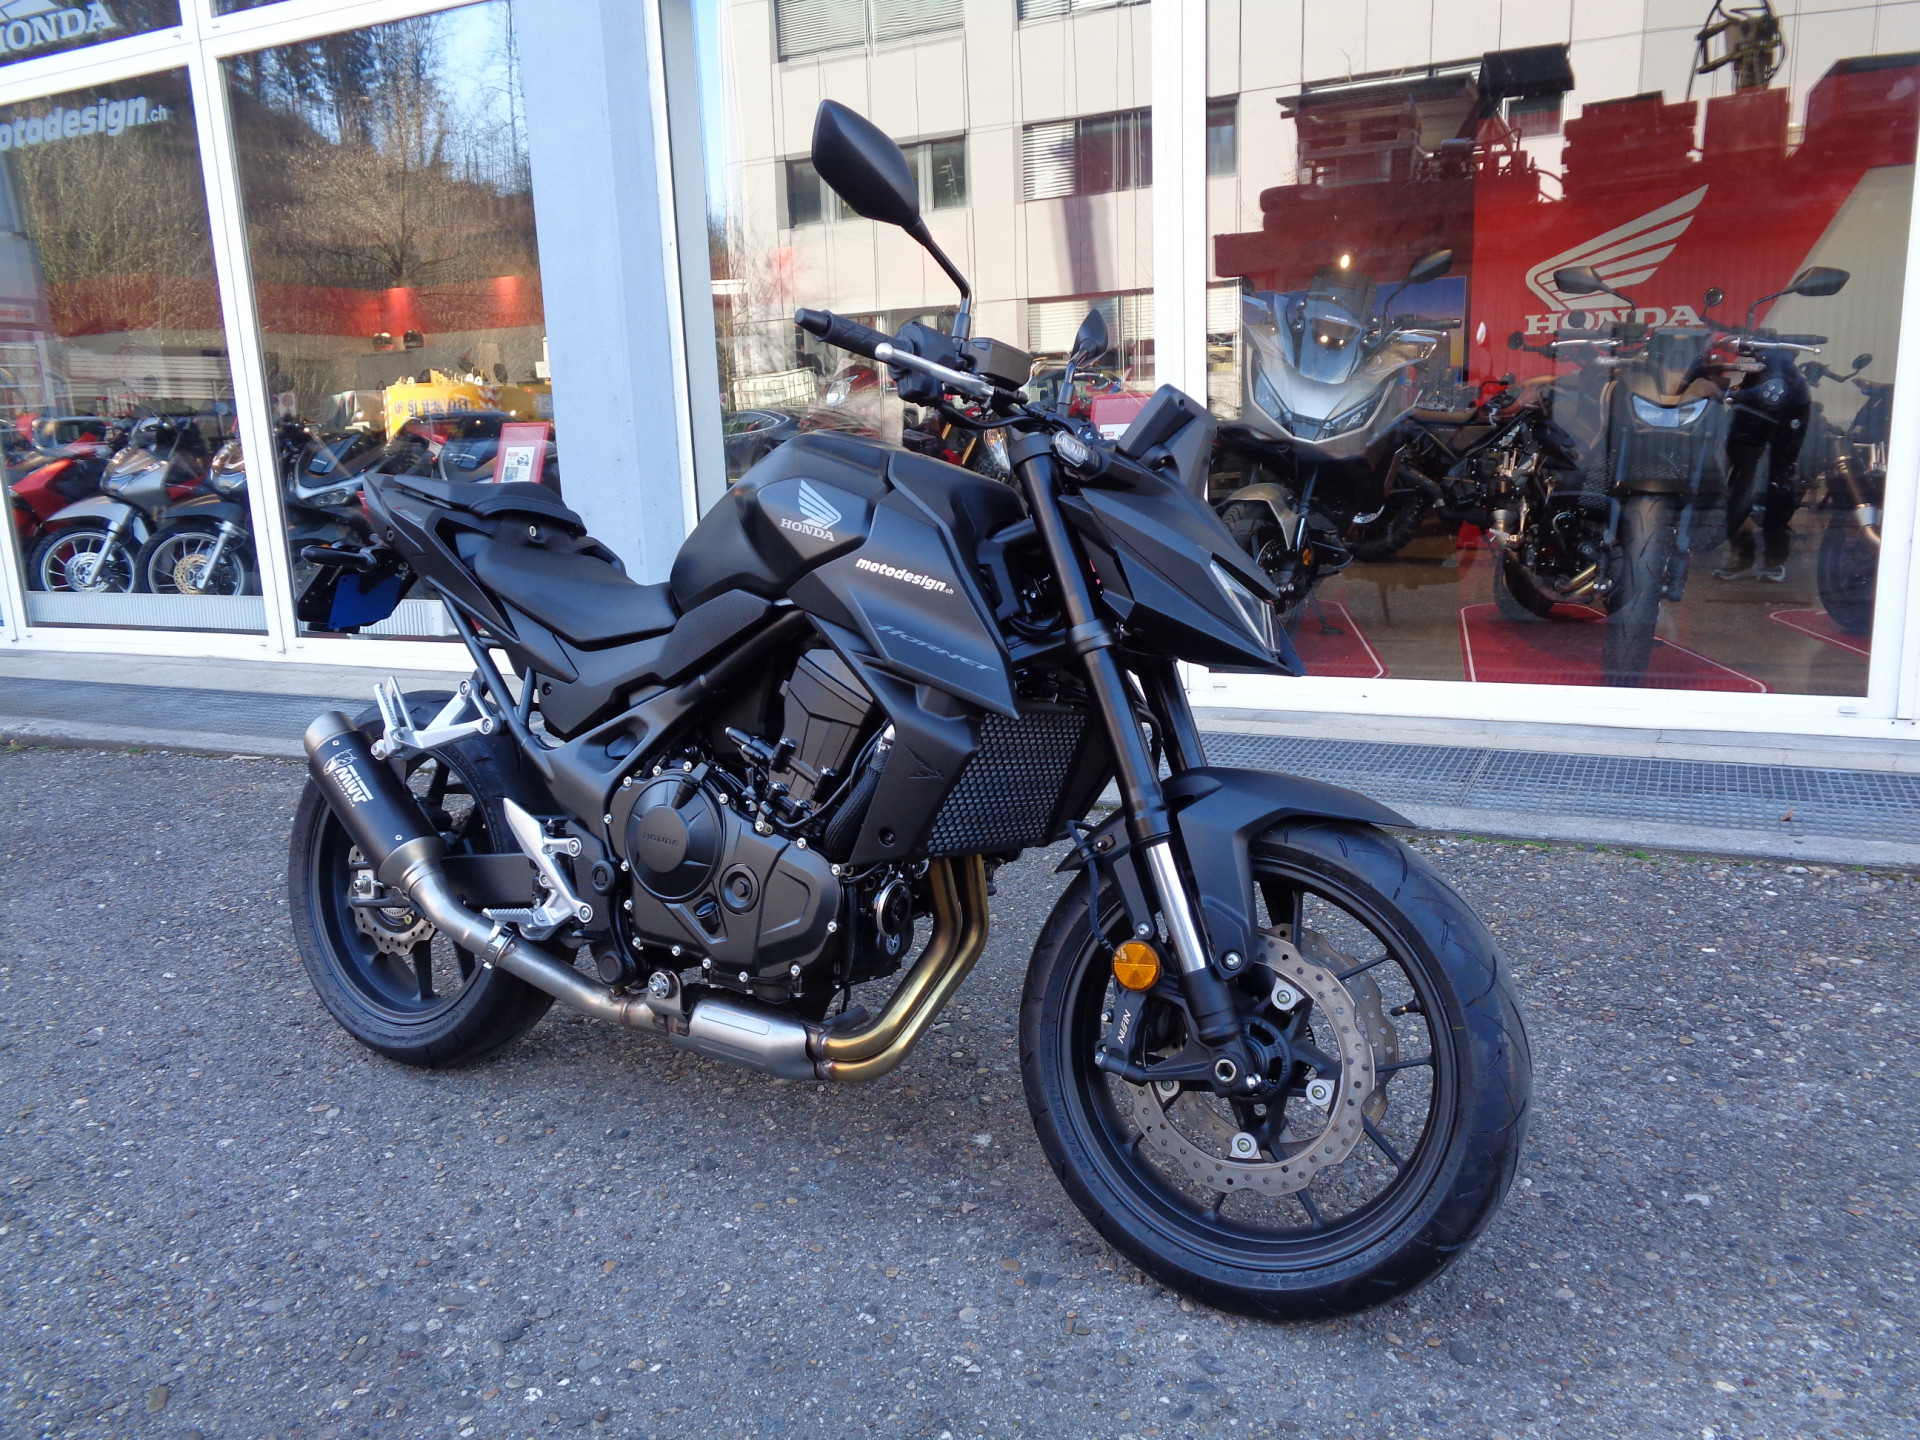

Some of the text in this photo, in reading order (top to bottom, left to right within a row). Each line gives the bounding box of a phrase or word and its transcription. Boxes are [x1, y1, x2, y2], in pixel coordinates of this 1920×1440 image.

[0, 96, 168, 152] otodesign.ch
[1524, 305, 1704, 335] HONDA
[779, 517, 835, 542] HONDA
[855, 557, 954, 595] motodesign.ch
[641, 832, 681, 848] HONDA
